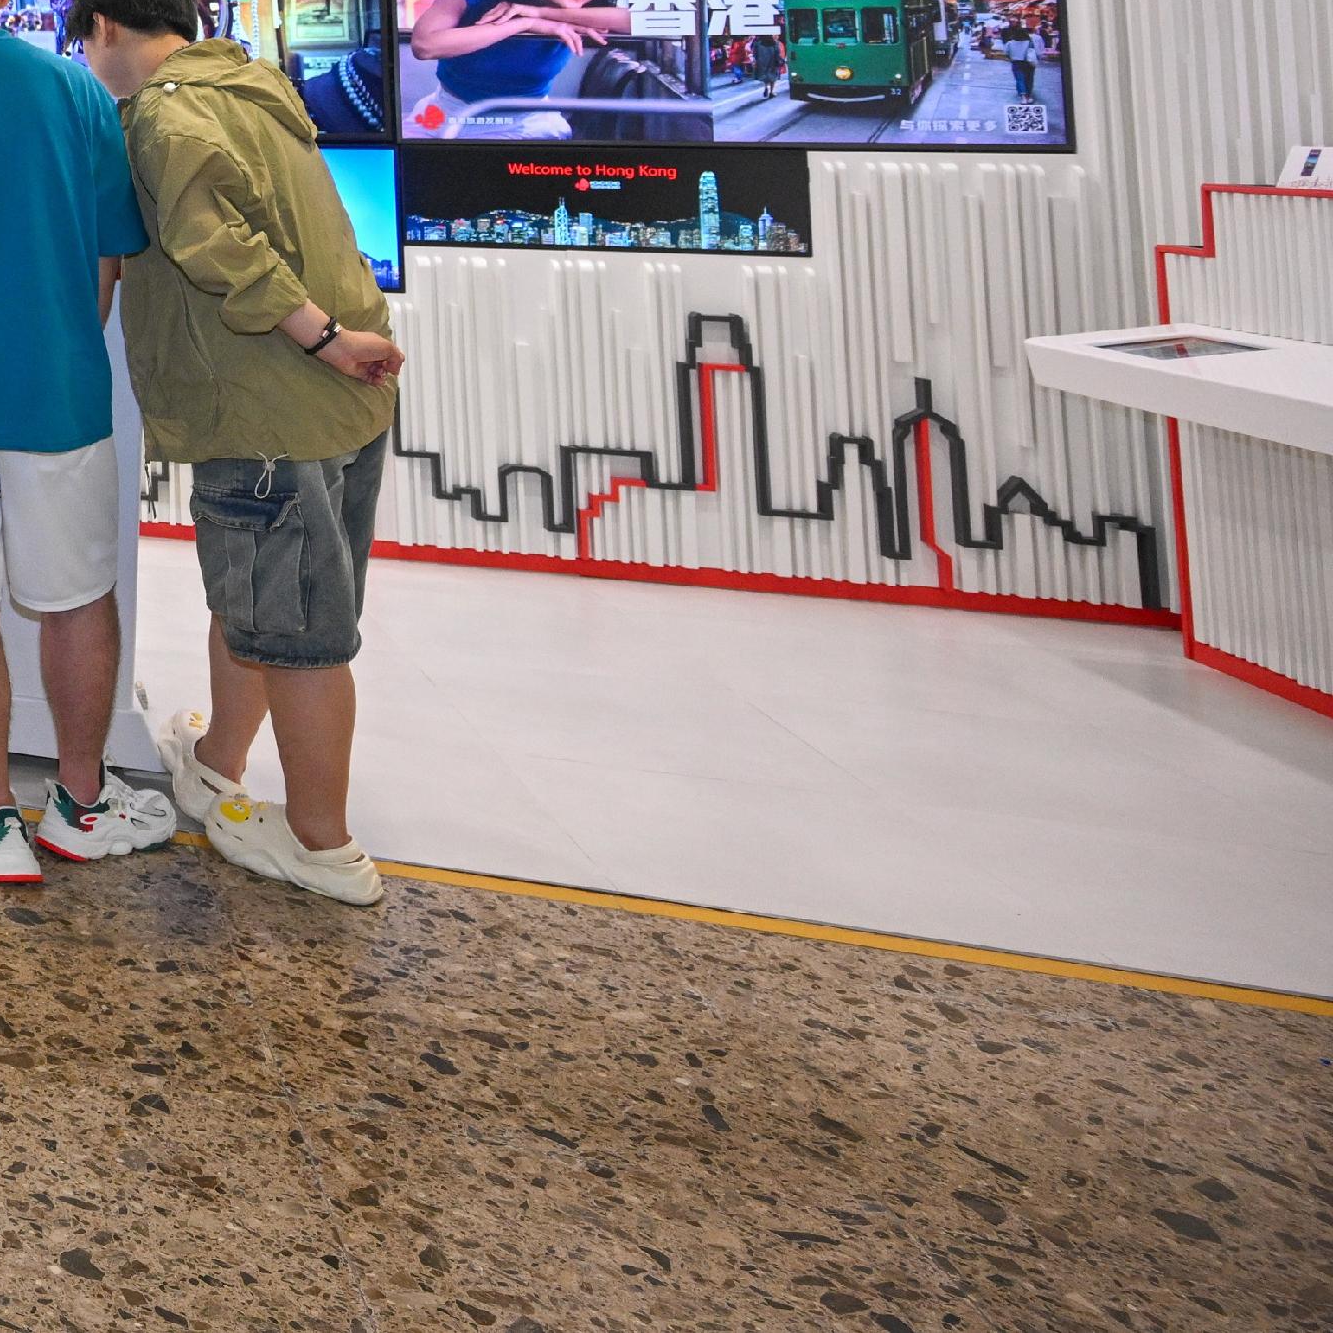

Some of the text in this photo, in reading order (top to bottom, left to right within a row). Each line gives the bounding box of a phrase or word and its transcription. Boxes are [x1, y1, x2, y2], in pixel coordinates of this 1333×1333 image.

[507, 162, 573, 176] Welcome
[576, 164, 593, 177] to
[595, 164, 636, 179] Hong
